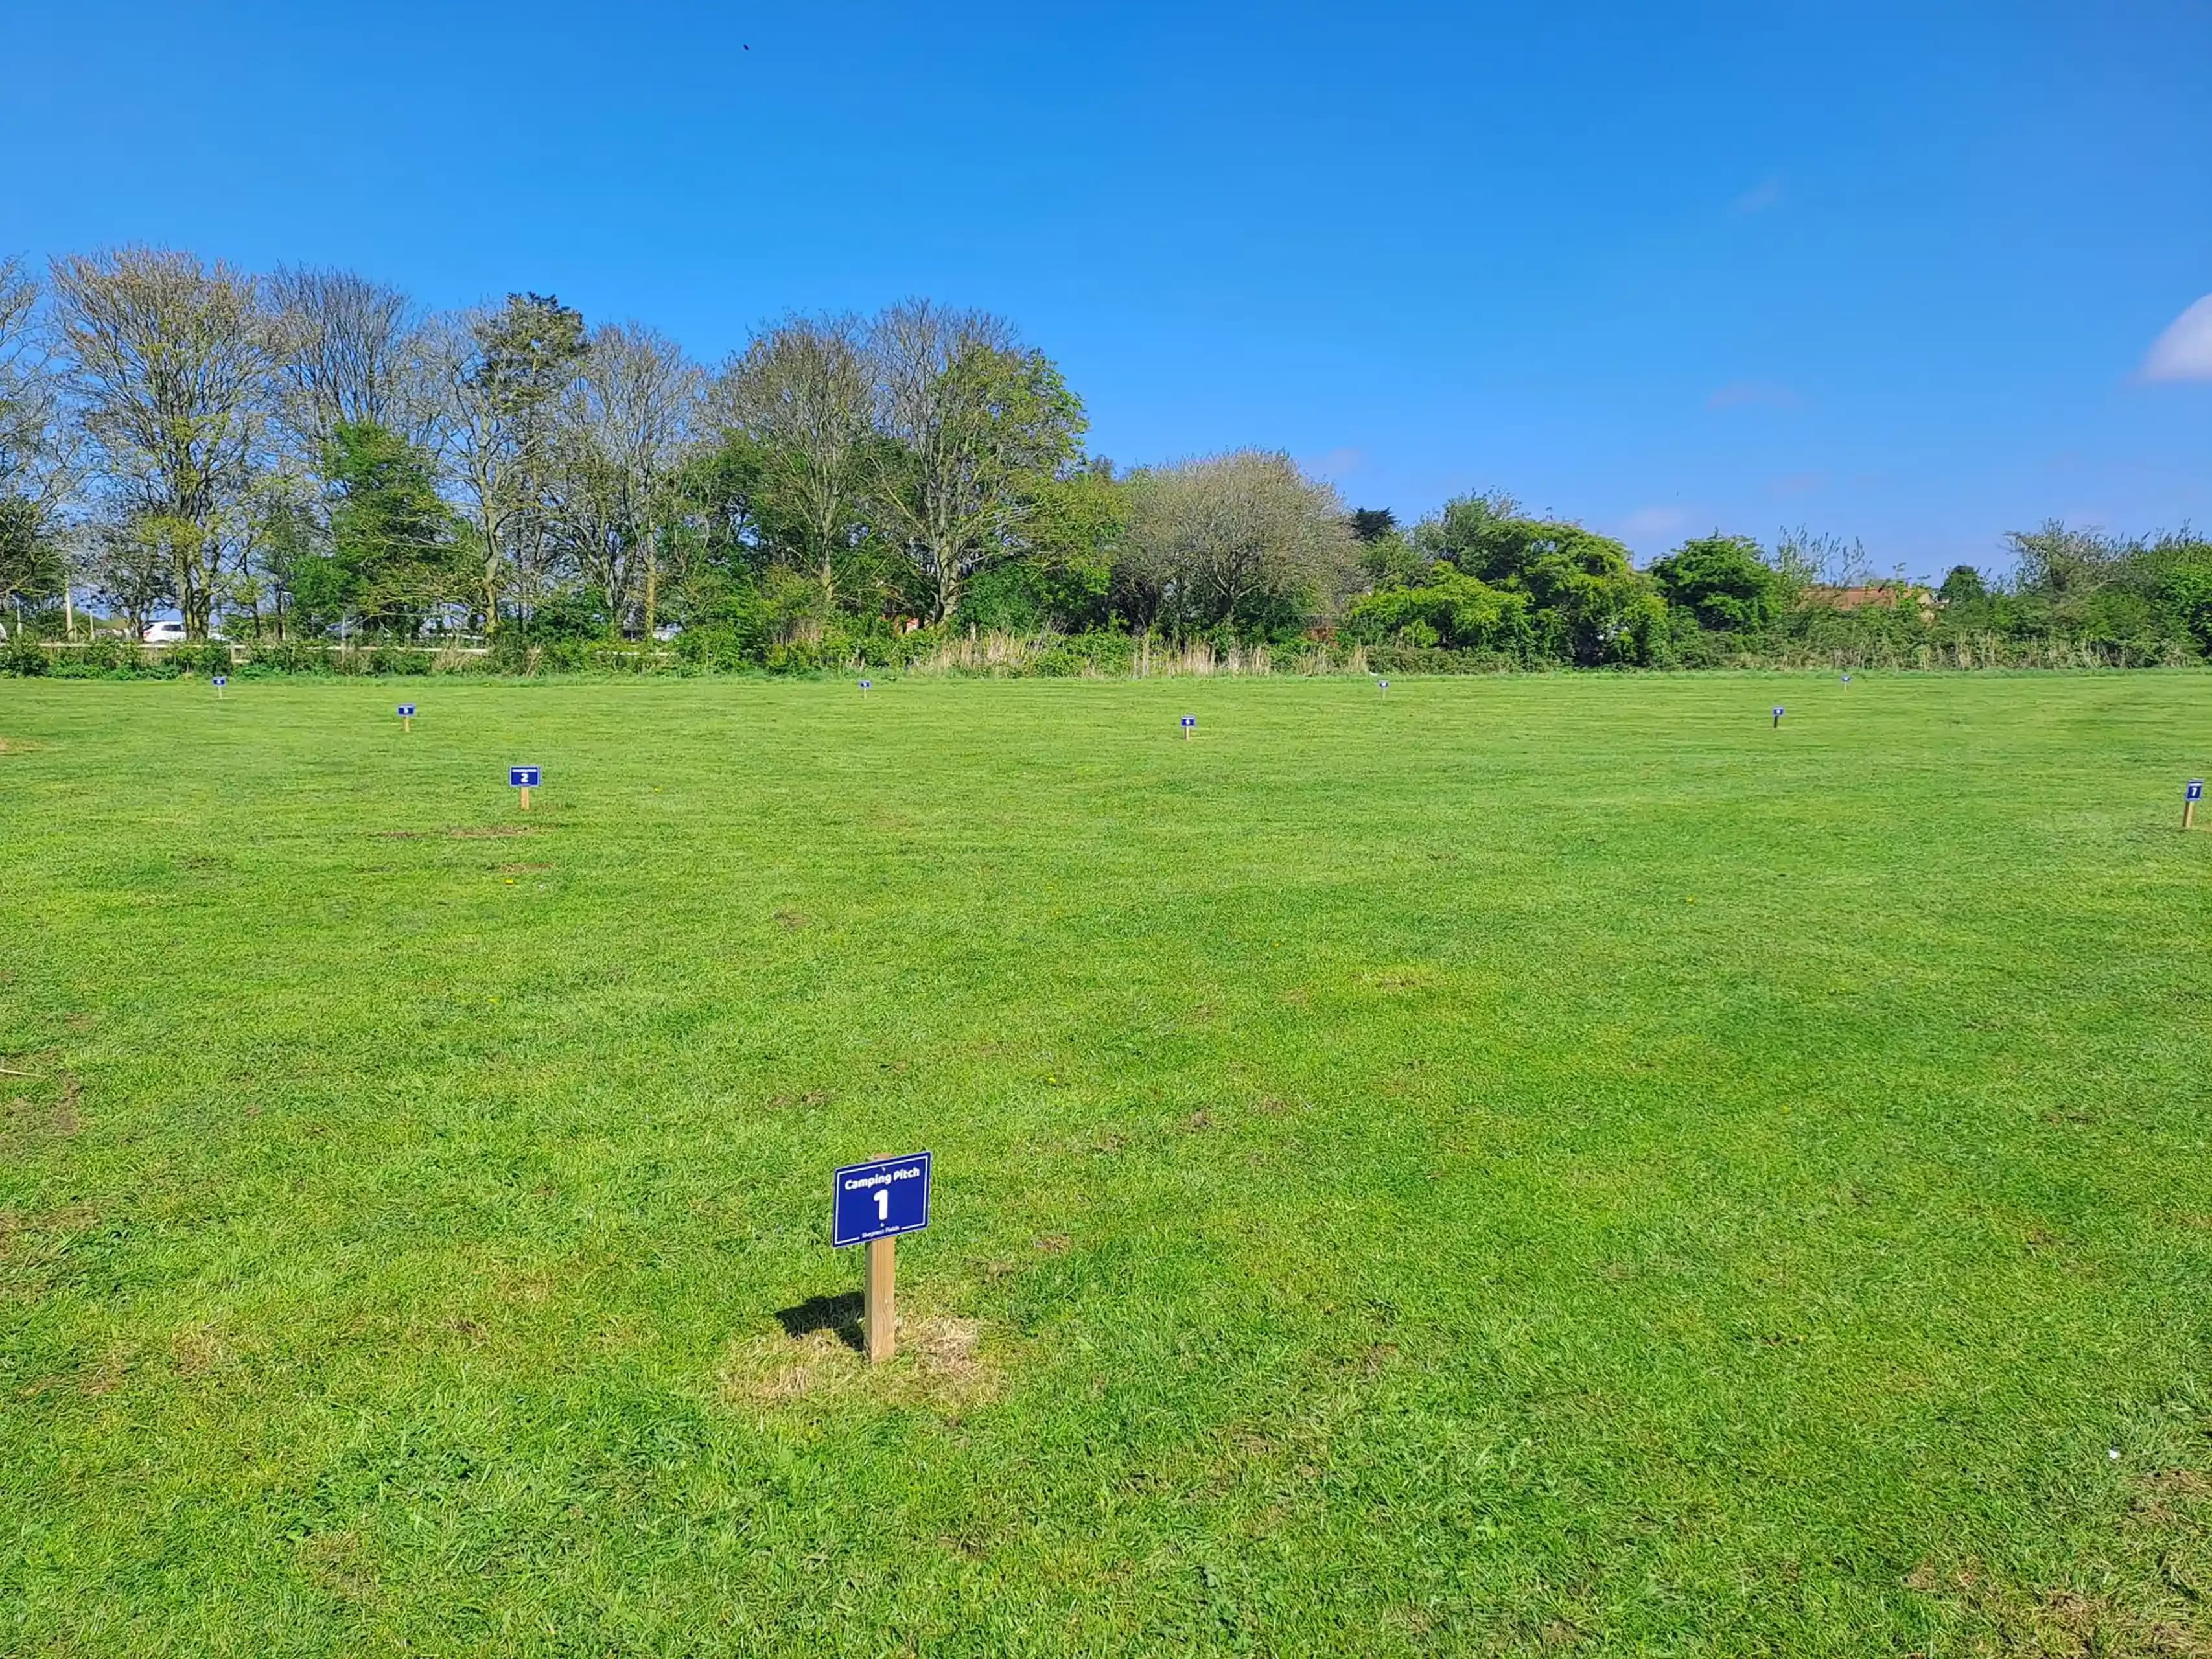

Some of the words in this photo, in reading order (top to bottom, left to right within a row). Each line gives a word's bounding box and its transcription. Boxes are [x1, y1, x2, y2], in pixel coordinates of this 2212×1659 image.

[520, 773, 529, 783] 2
[2191, 787, 2197, 796] 7
[844, 1174, 892, 1190] Camping
[893, 1167, 920, 1181] Pitch
[873, 1189, 889, 1220] 1
